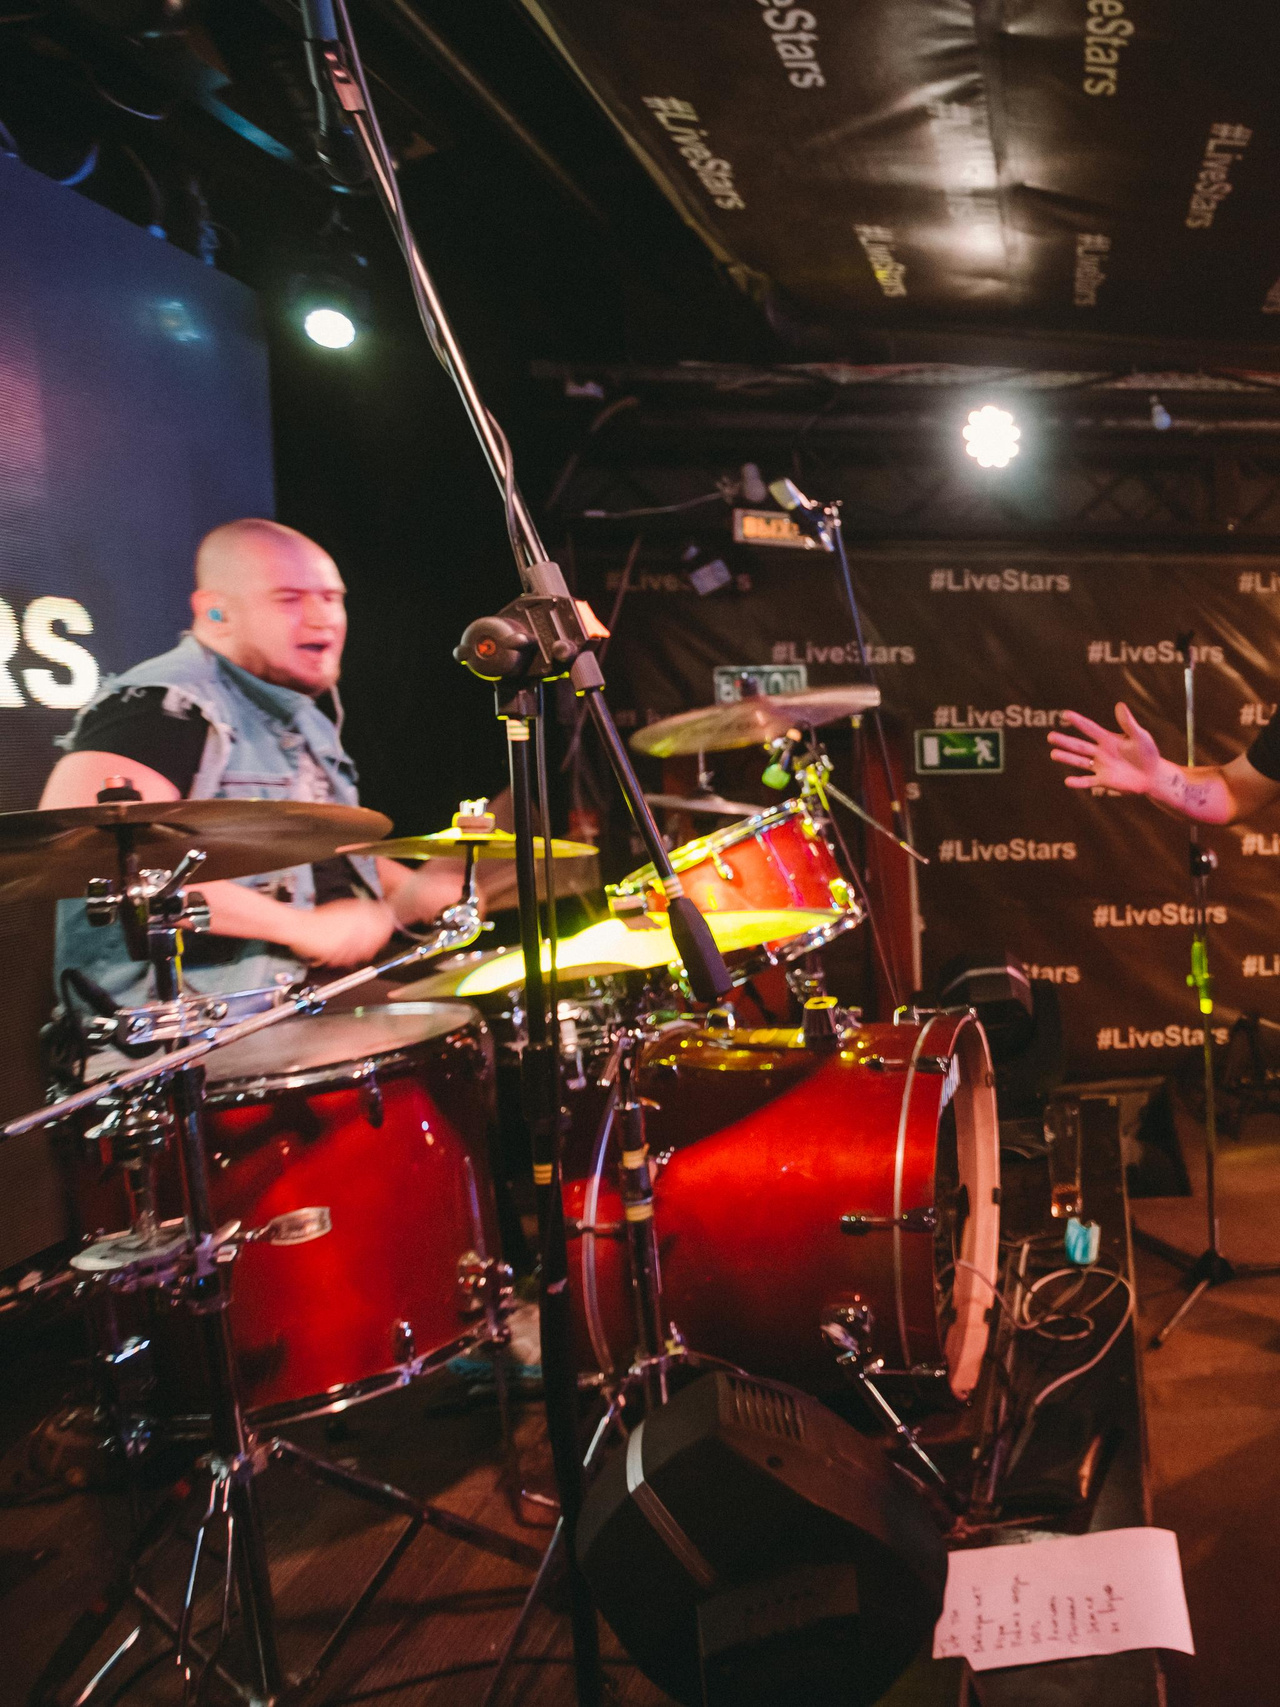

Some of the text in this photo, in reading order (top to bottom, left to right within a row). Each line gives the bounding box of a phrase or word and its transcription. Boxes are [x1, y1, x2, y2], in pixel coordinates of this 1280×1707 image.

[757, 0, 826, 88] Stars
[929, 568, 1071, 593] #LiveStars
[939, 838, 1078, 863] #LiveStars
[1096, 1024, 1230, 1051] #LiveStas
